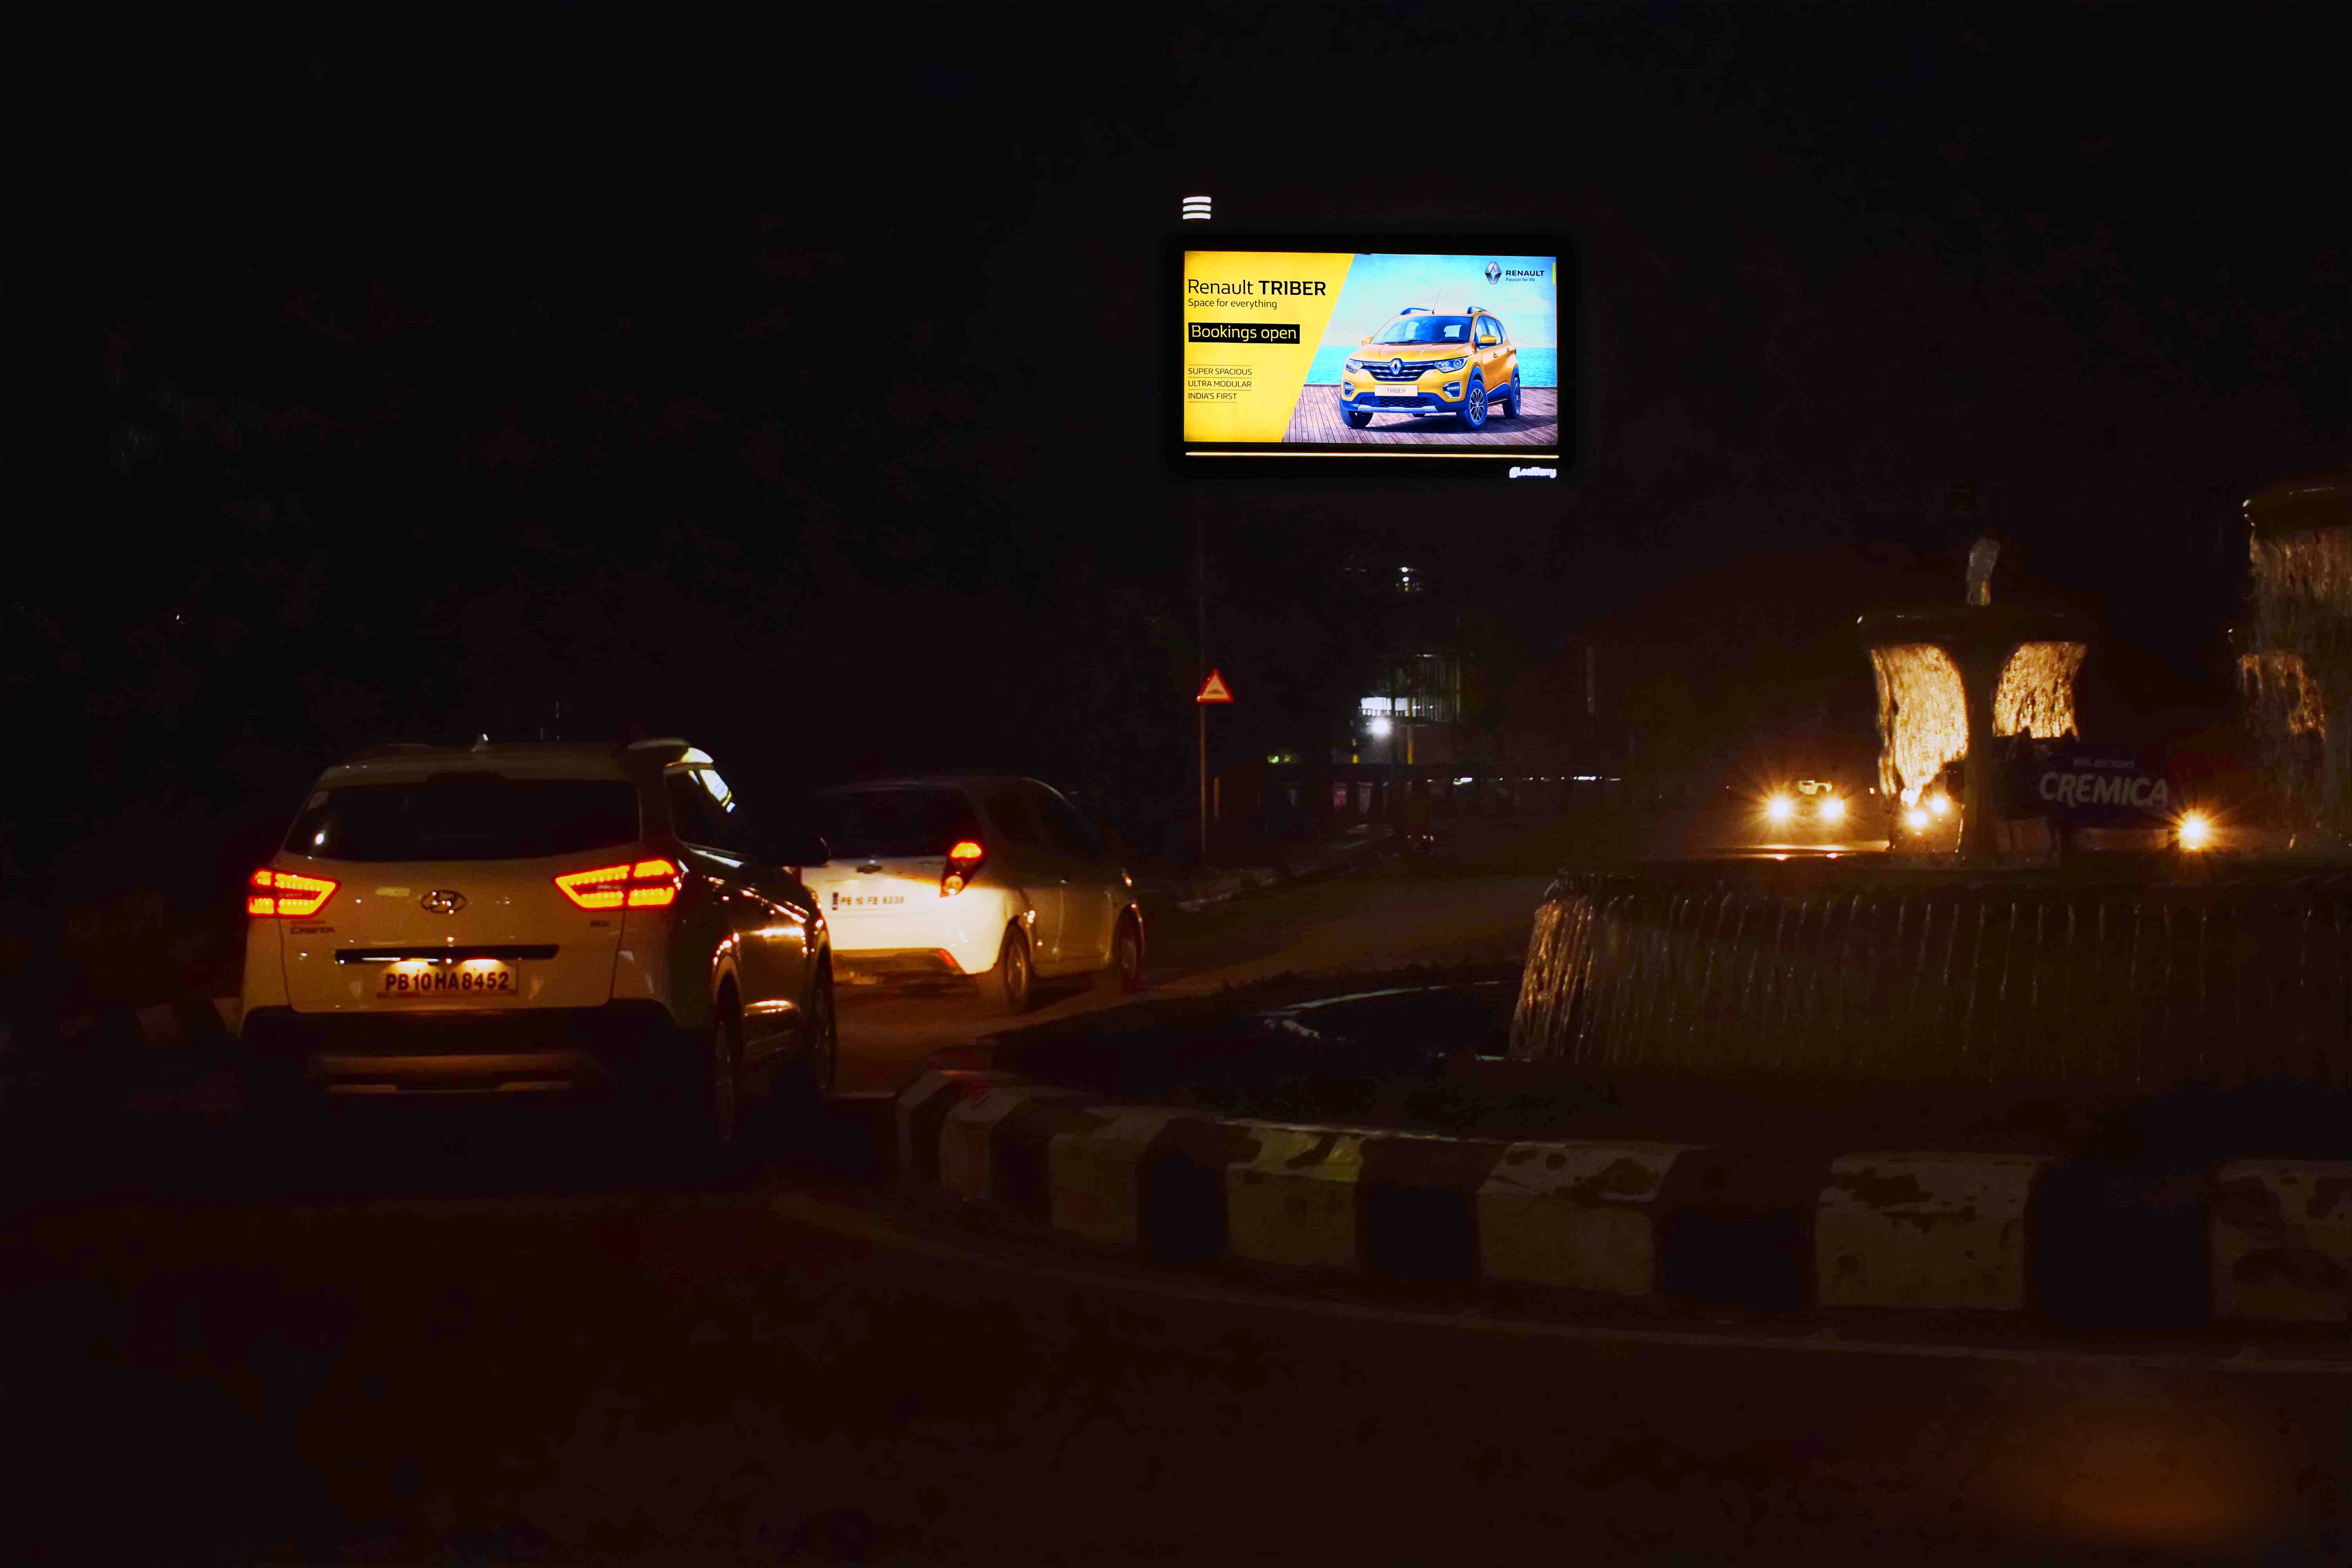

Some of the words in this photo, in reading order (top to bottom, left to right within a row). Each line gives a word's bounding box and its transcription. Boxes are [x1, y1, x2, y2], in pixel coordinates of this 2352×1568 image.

[1188, 279, 1253, 295] Renault
[1258, 281, 1326, 296] TRIBER
[1188, 298, 1214, 308] Space
[1216, 298, 1229, 307] for
[1231, 299, 1277, 309] everything
[1191, 325, 1257, 342] Bookings
[1261, 328, 1297, 342] open
[2040, 771, 2170, 808] CREMICA
